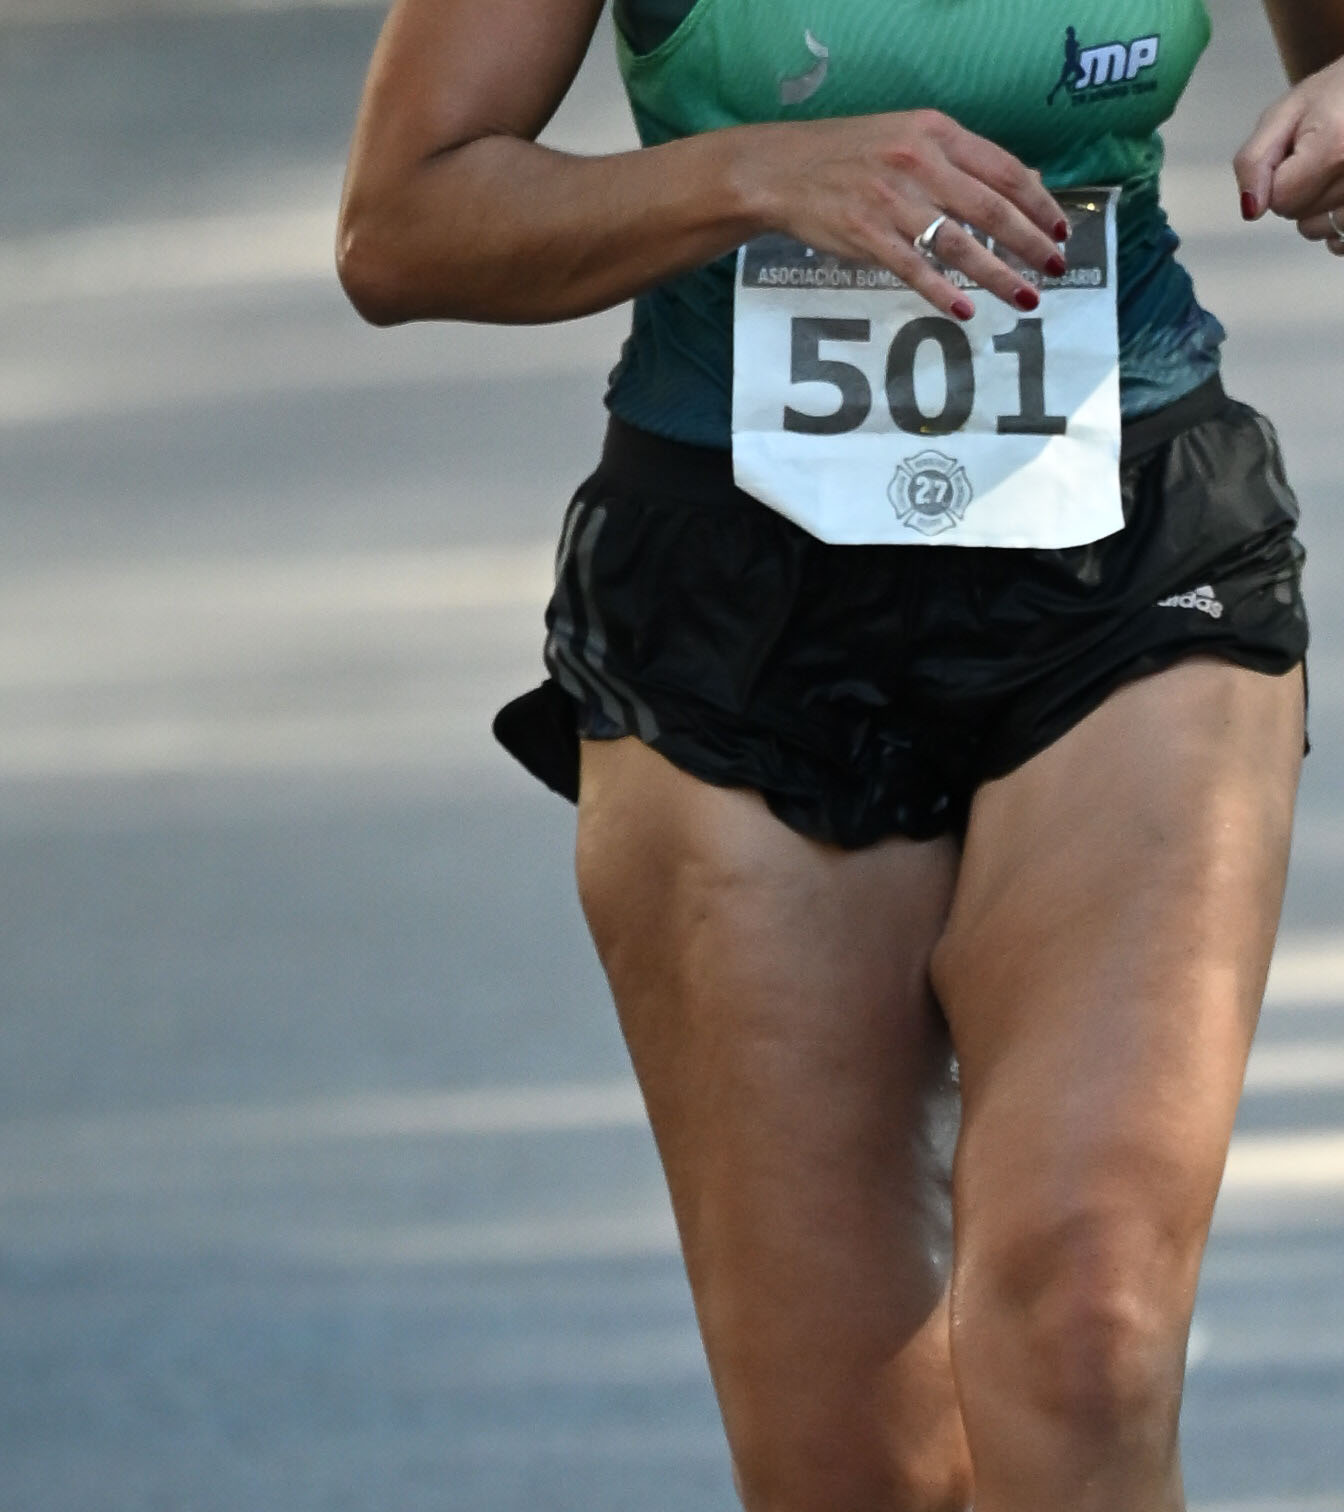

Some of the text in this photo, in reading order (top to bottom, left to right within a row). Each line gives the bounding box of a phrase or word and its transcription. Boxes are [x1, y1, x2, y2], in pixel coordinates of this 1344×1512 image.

[1075, 35, 1160, 89] MP
[783, 316, 1067, 436] 501
[914, 475, 948, 505] 27
